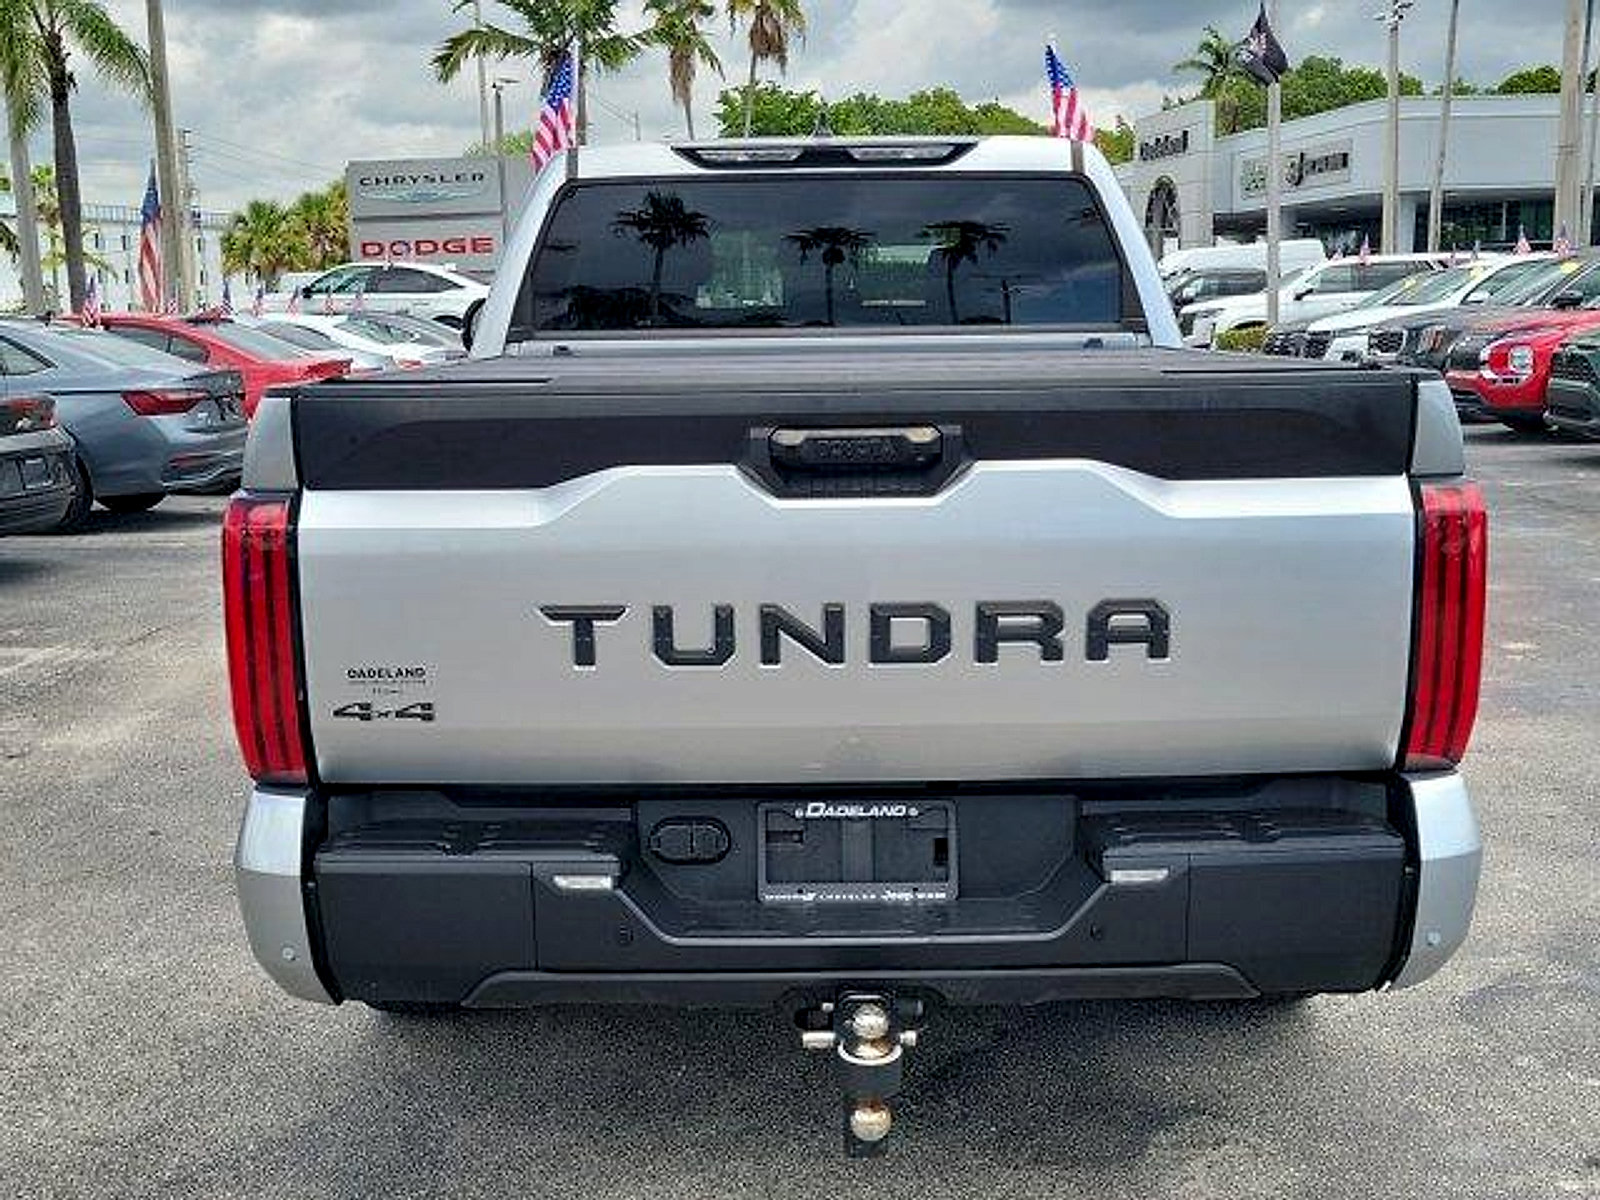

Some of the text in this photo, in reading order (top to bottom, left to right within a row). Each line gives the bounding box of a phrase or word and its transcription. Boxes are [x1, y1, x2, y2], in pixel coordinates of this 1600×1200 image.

[359, 172, 485, 187] CHRYSLER
[360, 237, 494, 259] DODGE
[539, 598, 1171, 668] TUNDRA
[346, 667, 427, 679] DADELAND
[333, 702, 435, 722] 4x4
